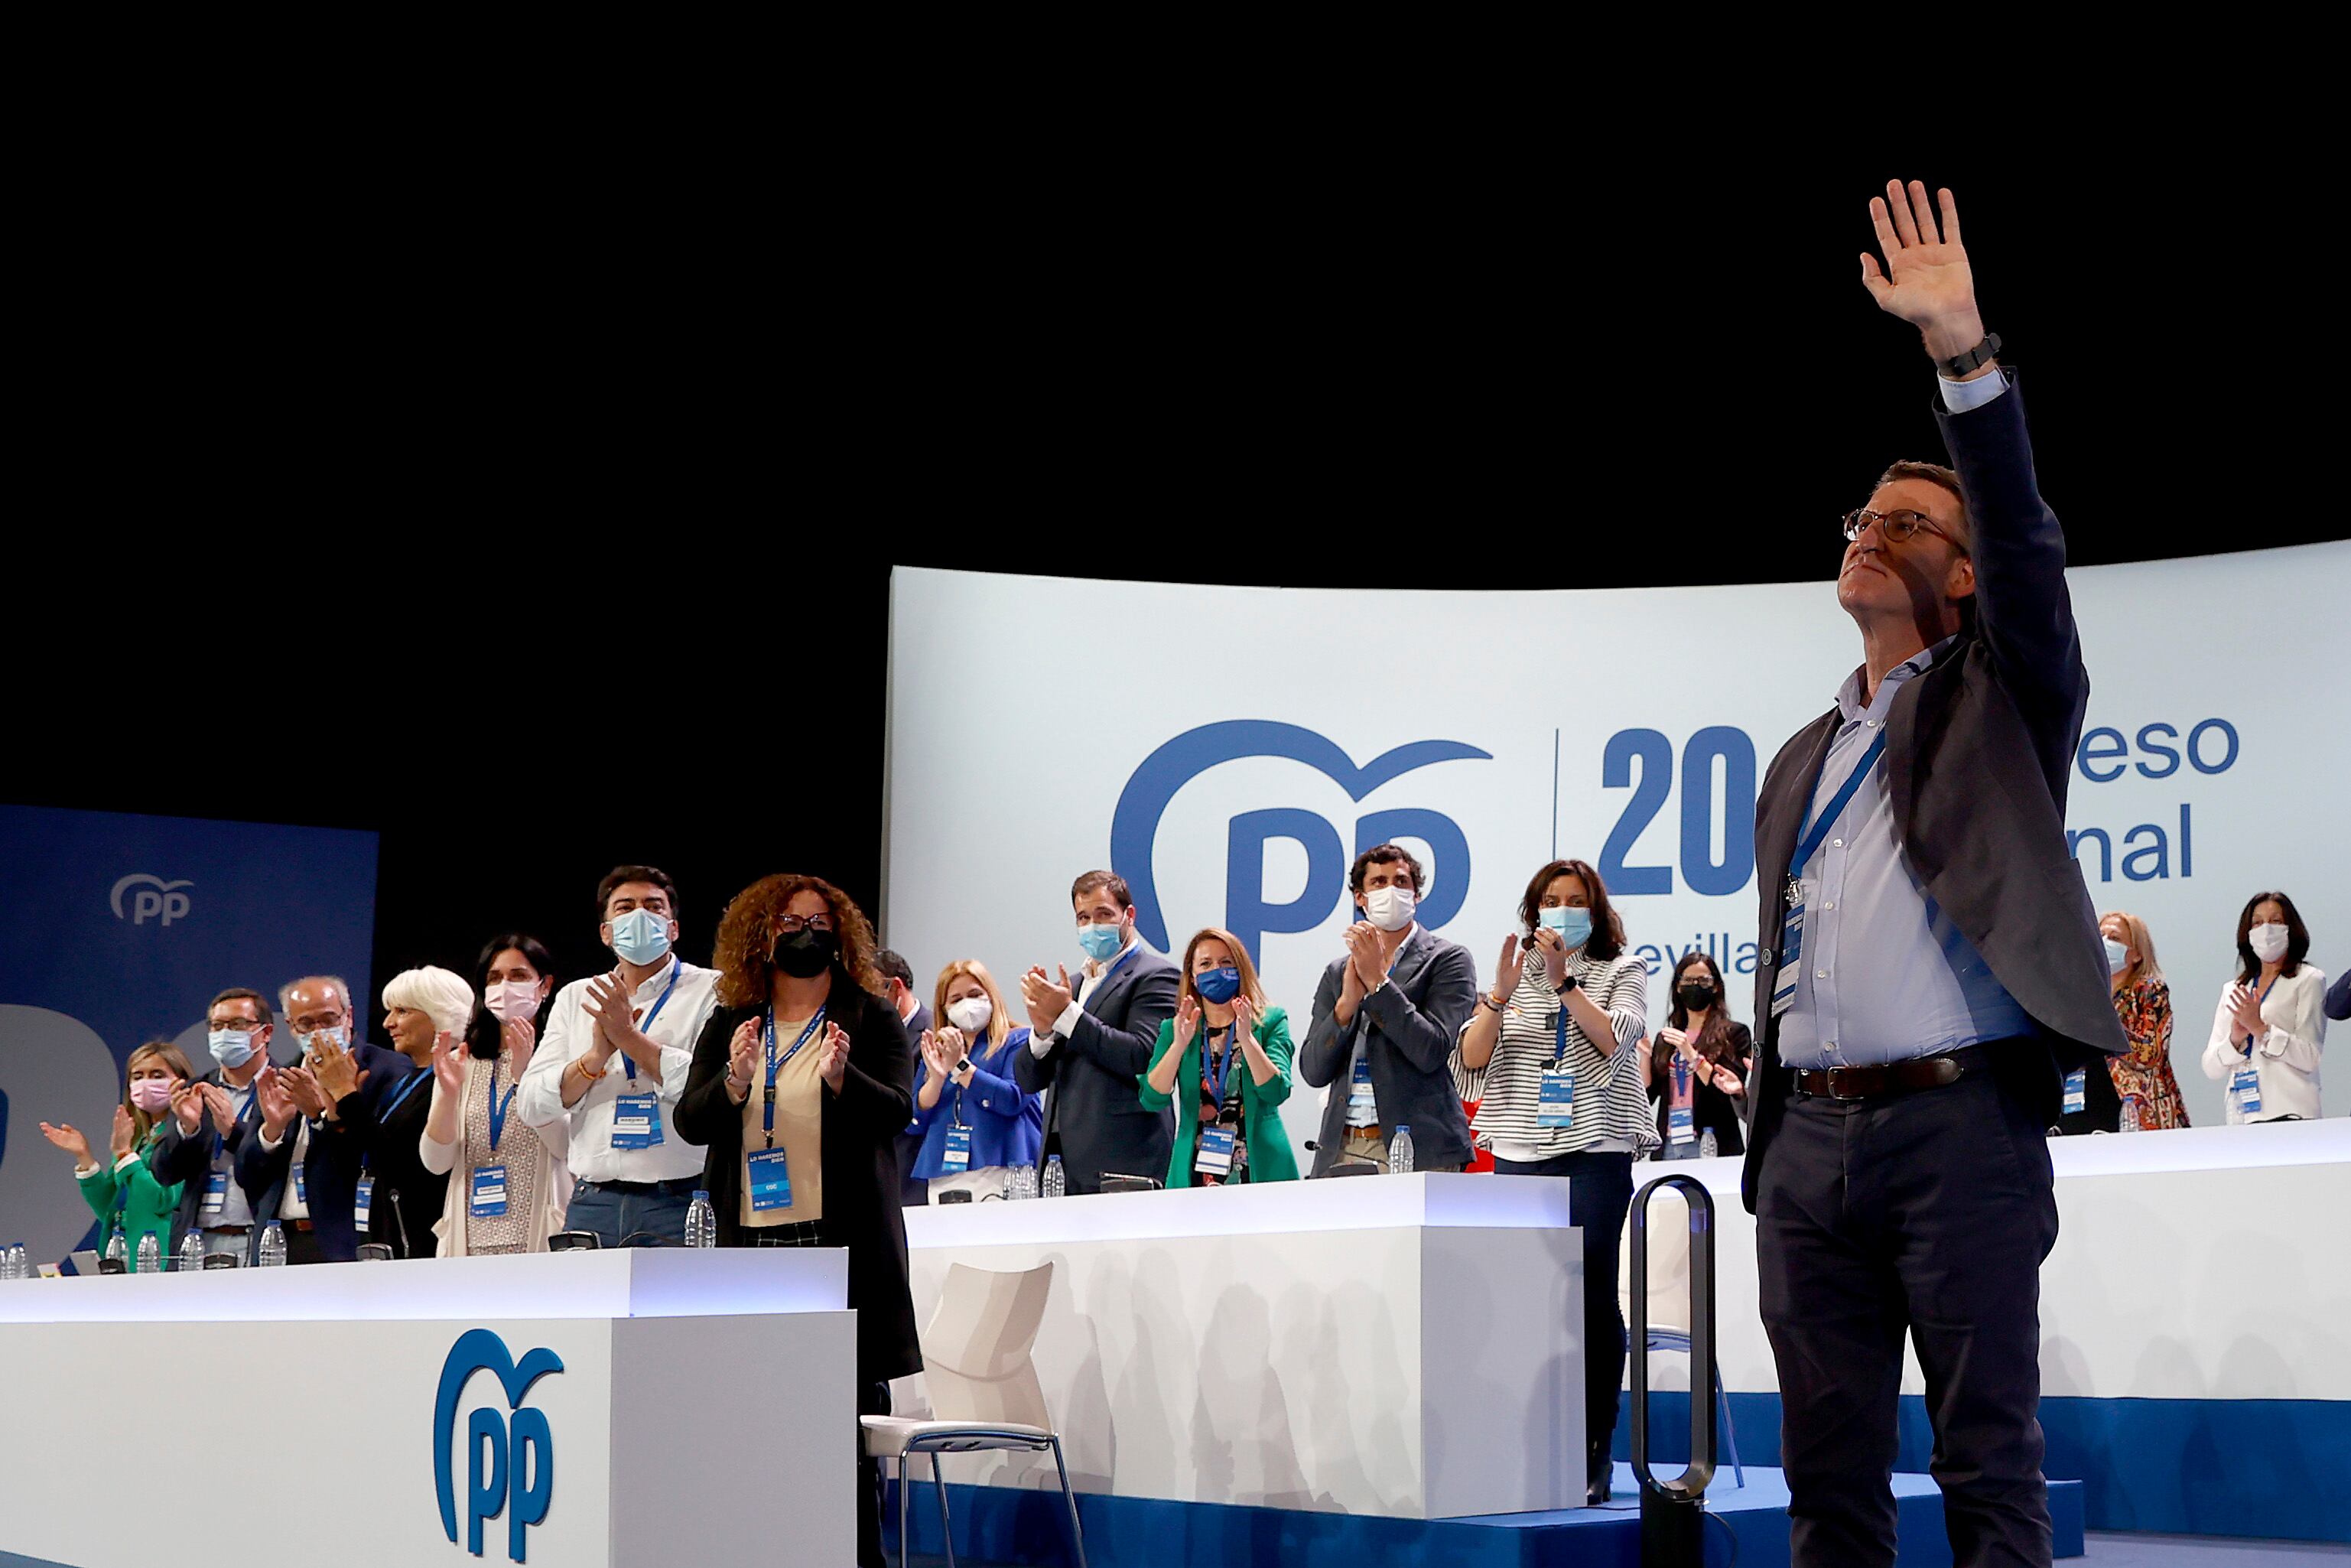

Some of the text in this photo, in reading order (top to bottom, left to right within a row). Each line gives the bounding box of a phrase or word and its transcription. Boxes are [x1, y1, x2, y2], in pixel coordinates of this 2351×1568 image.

[2076, 717, 2239, 782] eso
[1597, 725, 1757, 896] 20
[2066, 803, 2192, 883] nal
[1634, 932, 1759, 975] evilla
